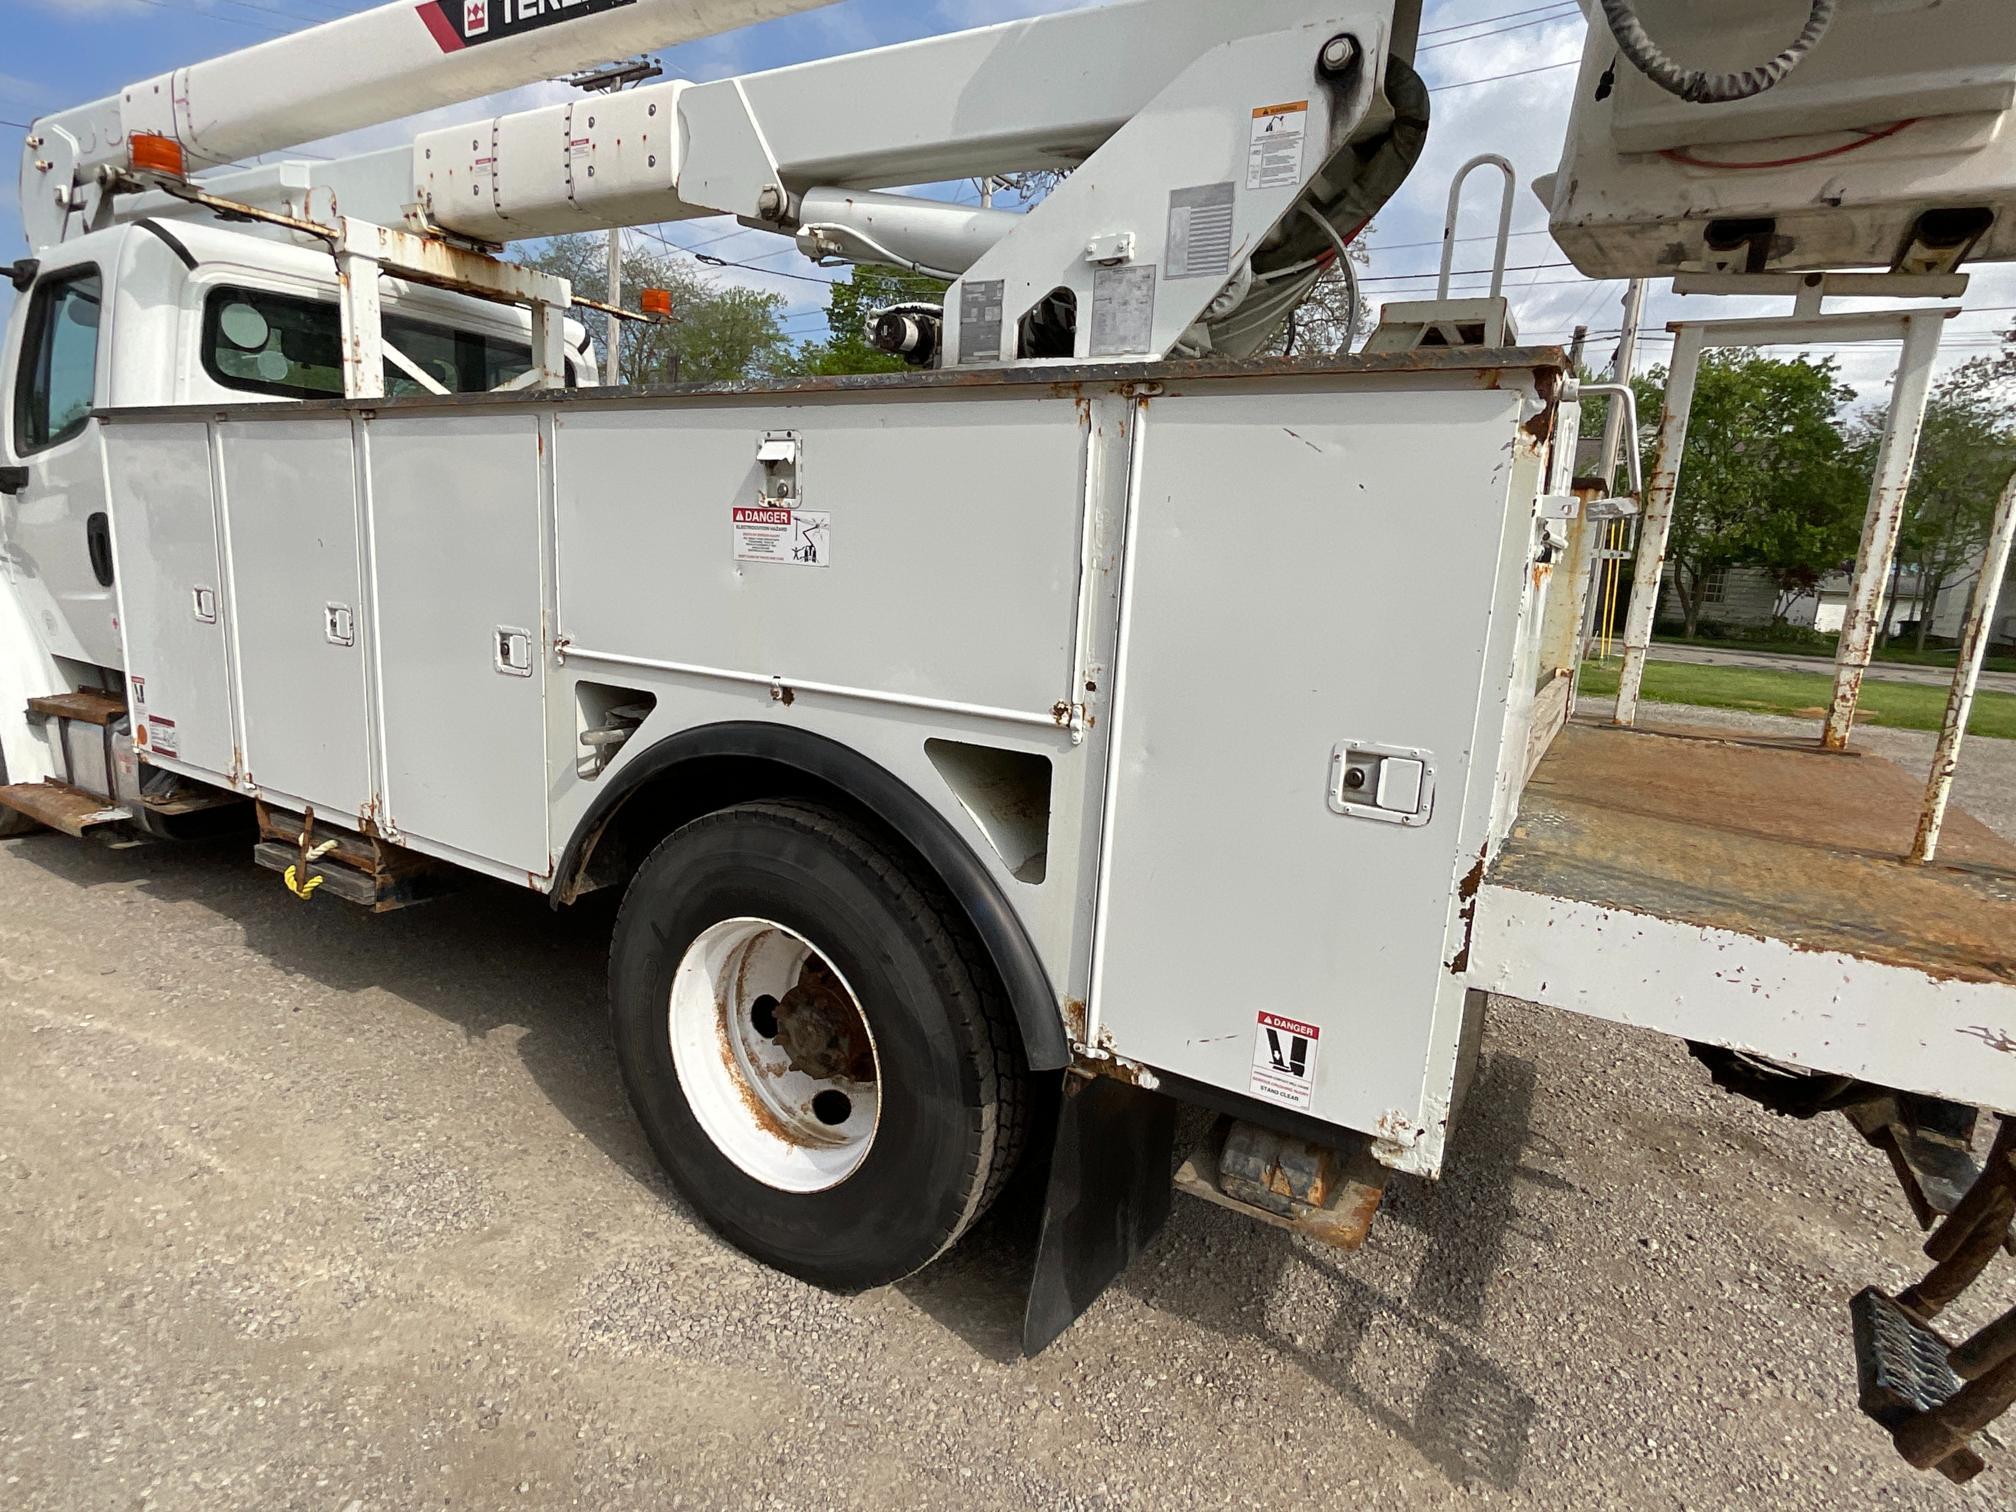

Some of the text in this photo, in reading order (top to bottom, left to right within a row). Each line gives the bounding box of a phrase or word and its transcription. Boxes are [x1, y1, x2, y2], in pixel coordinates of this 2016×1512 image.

[745, 511, 788, 524] DANGER
[1273, 1018, 1314, 1036] DANGER
[1260, 1085, 1299, 1101] STAND CLEAR
